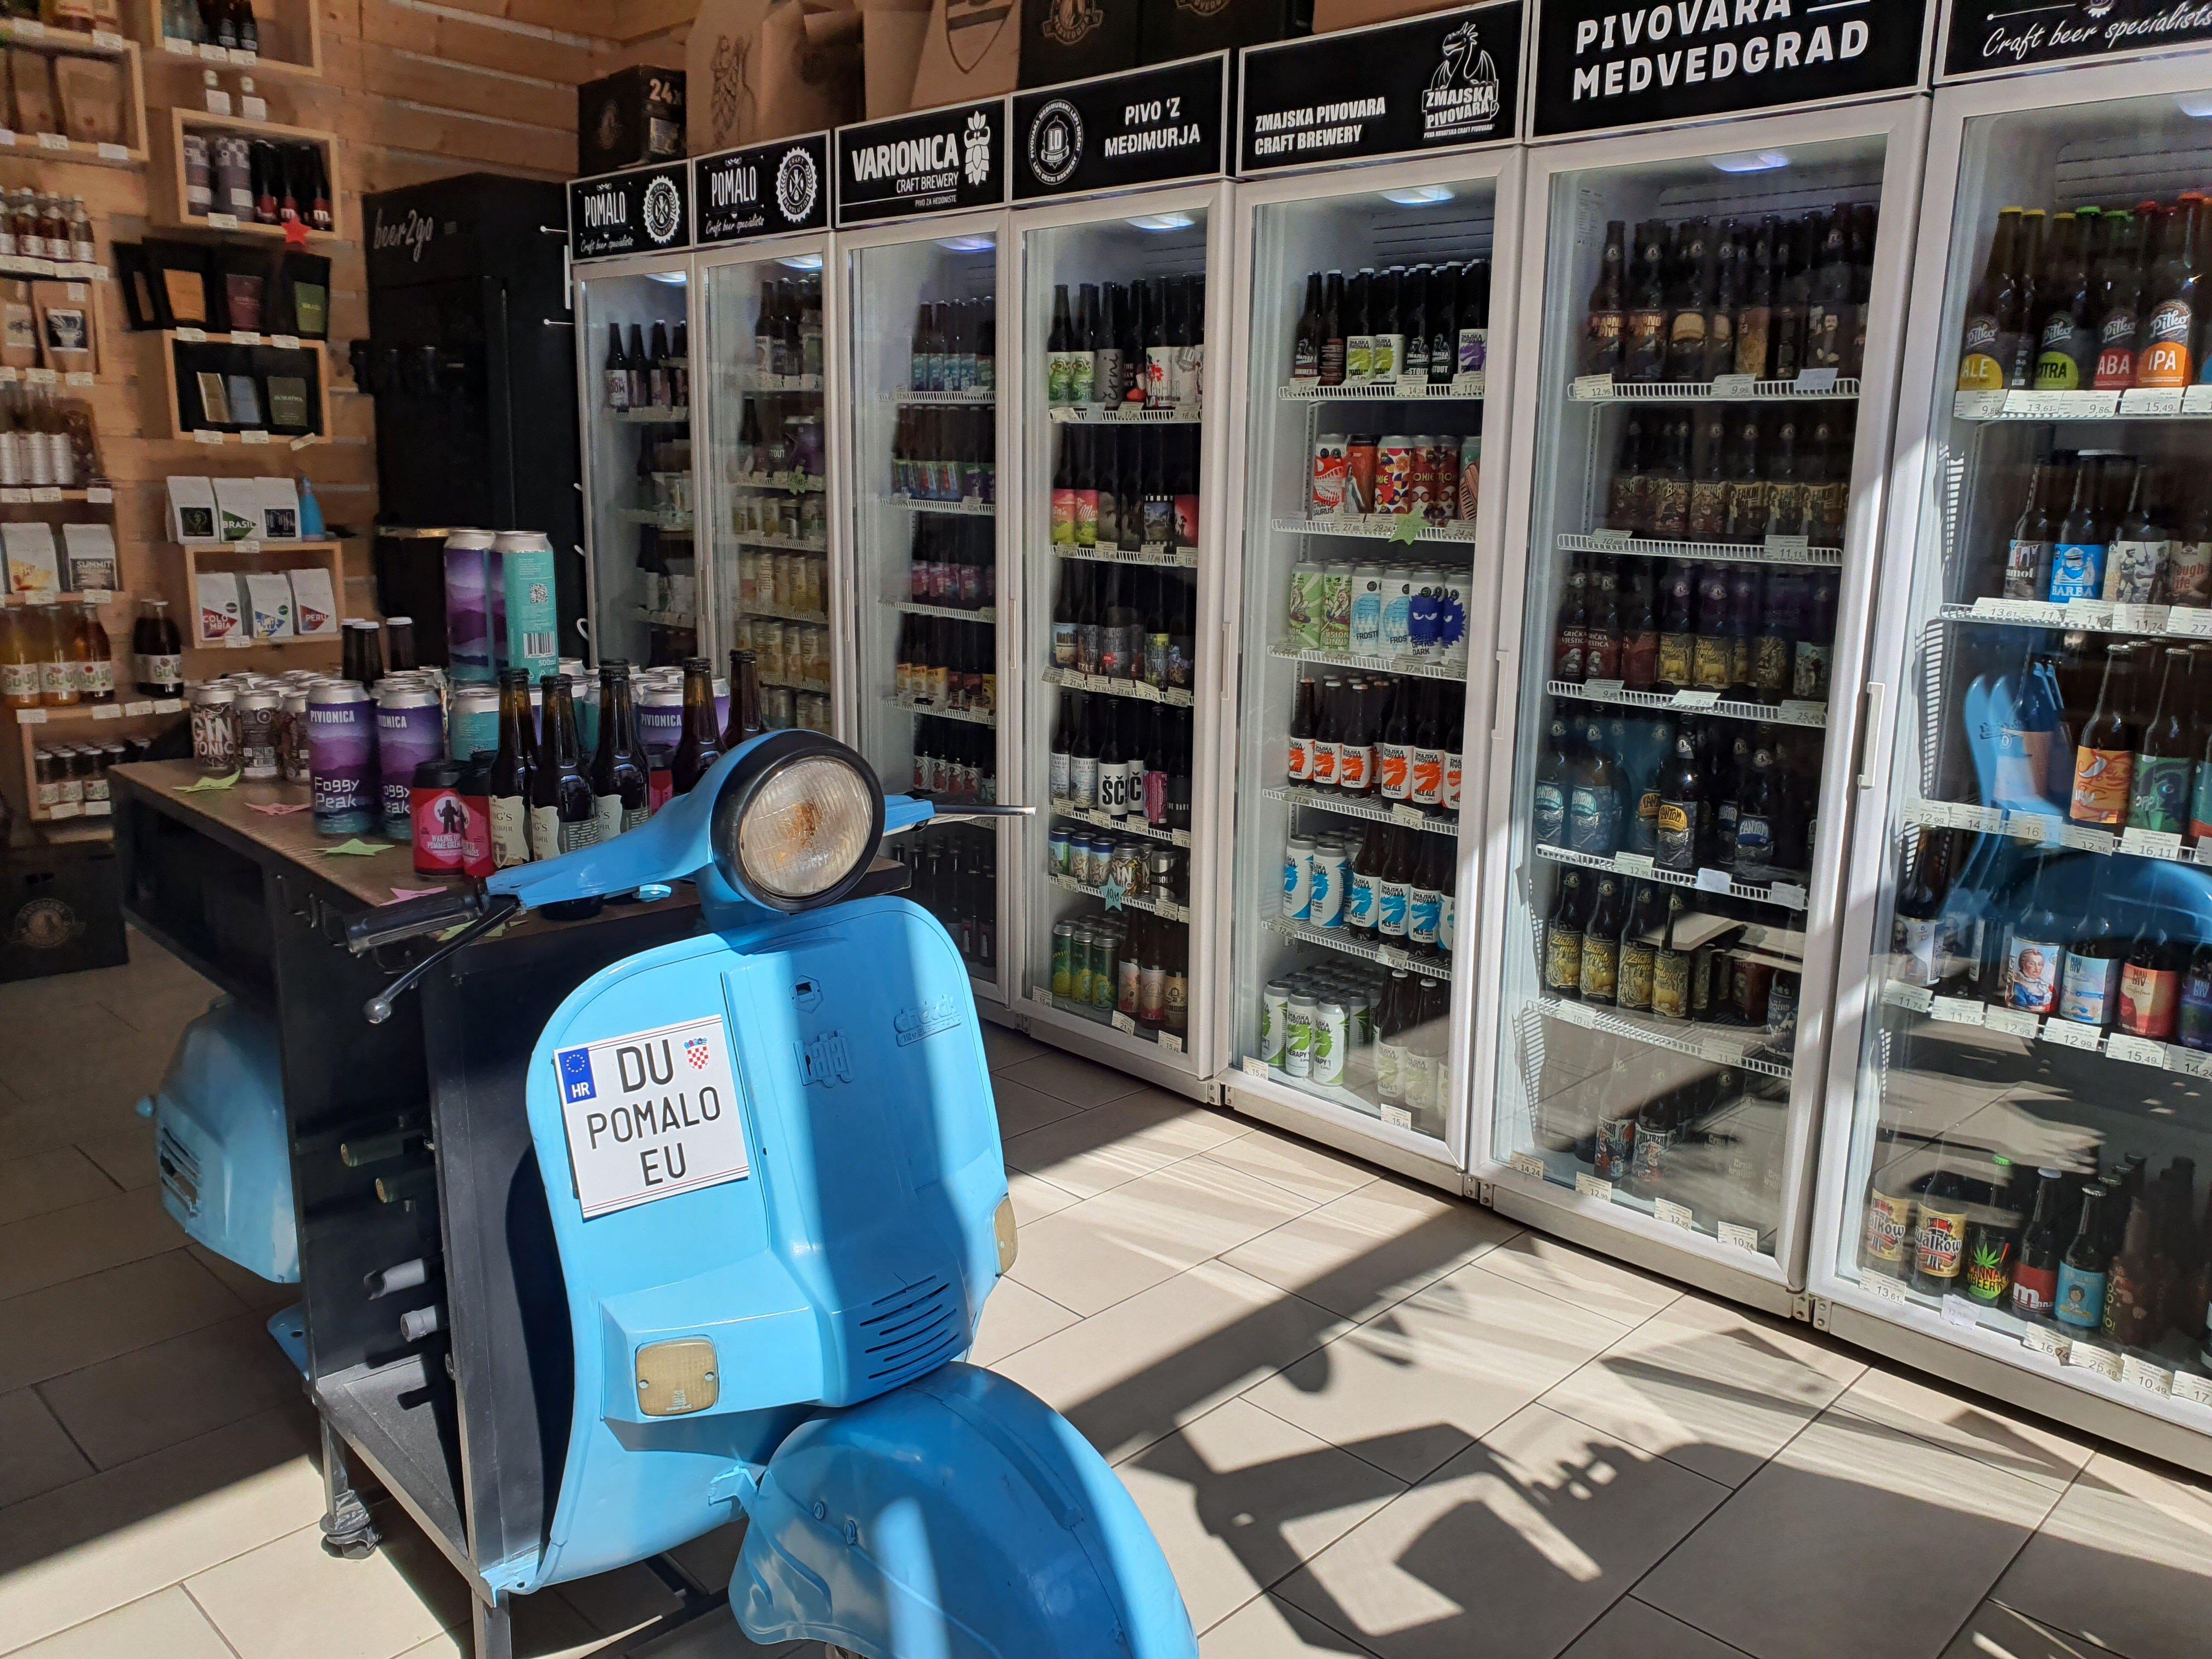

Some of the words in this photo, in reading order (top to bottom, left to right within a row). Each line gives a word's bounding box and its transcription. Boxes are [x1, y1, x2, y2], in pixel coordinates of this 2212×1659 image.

[1576, 0, 1791, 54] PIVOVARA
[1983, 22, 2045, 60] Craft
[2048, 20, 2098, 47] beer
[2104, 1, 2212, 49] specialists
[1573, 20, 1869, 101] MEDVEDGRAD
[1426, 85, 1494, 107] ZMAJSKA
[1125, 101, 1161, 126] PIVO
[1255, 108, 1313, 132] ZMAJSKA
[1317, 97, 1386, 123] PIVOVARA
[1426, 99, 1491, 128] PIVOVARA
[1105, 123, 1200, 157] MEĐIMURJA
[1255, 133, 1293, 155] CRAFT
[1297, 125, 1362, 150] BREWERY
[852, 133, 960, 182] VARIONICA
[712, 166, 756, 207] POMALO
[896, 177, 919, 193] CRAFT
[921, 172, 959, 190] BREWERY
[585, 191, 626, 228] POMALO
[706, 220, 721, 238] Craft
[723, 219, 735, 233] beer
[737, 213, 765, 233] specialists
[373, 209, 434, 263] beer2go
[580, 238, 595, 255] Craft
[2097, 354, 2130, 375] ABA
[1592, 387, 1612, 397] 12,99
[2027, 404, 2054, 413] 13,61
[2089, 404, 2111, 414] 9,86
[2146, 401, 2174, 412] 15,49
[76, 560, 112, 569] SUMMIT
[2052, 585, 2094, 596] BARBA
[203, 615, 228, 623] COLO
[1991, 607, 2017, 618] 13,61
[2134, 619, 2163, 631] 11,74
[1564, 629, 1587, 638] GRIČKA
[310, 710, 355, 724] PIVIONICA
[641, 714, 682, 727] PIVIONICA
[191, 716, 232, 743] GIN
[314, 776, 359, 793] Foggy
[315, 792, 357, 809] Peak
[386, 799, 411, 815] eak
[1658, 806, 1682, 823] FANTOM
[1920, 812, 1944, 825] 12,99
[1739, 820, 1769, 836] FANTOM
[1968, 818, 1994, 832] 14,24
[2139, 845, 2173, 859] 16,11
[1630, 866, 1650, 877] 12,99
[1552, 935, 1577, 949] Zlatni
[1584, 941, 1607, 955] Zlatni
[2063, 1034, 2092, 1048] 12,99
[2127, 1050, 2157, 1064] 15,49
[616, 1039, 674, 1093] DU
[1252, 1069, 1267, 1079] 15,49
[571, 1082, 590, 1098] HR
[586, 1086, 721, 1150] POMALO
[1392, 1118, 1409, 1129] 15,49
[640, 1142, 687, 1187] EU
[1520, 1164, 1541, 1177] 14,24
[1590, 1188, 1609, 1201] 12,99
[1671, 1215, 1691, 1228] 12,99
[1733, 1236, 1756, 1251] 10,74
[1877, 1285, 1900, 1302] 13,61
[2041, 1341, 2070, 1361] 16,74
[2089, 1359, 2117, 1379] 25,49
[2138, 1376, 2167, 1395] 10,49
